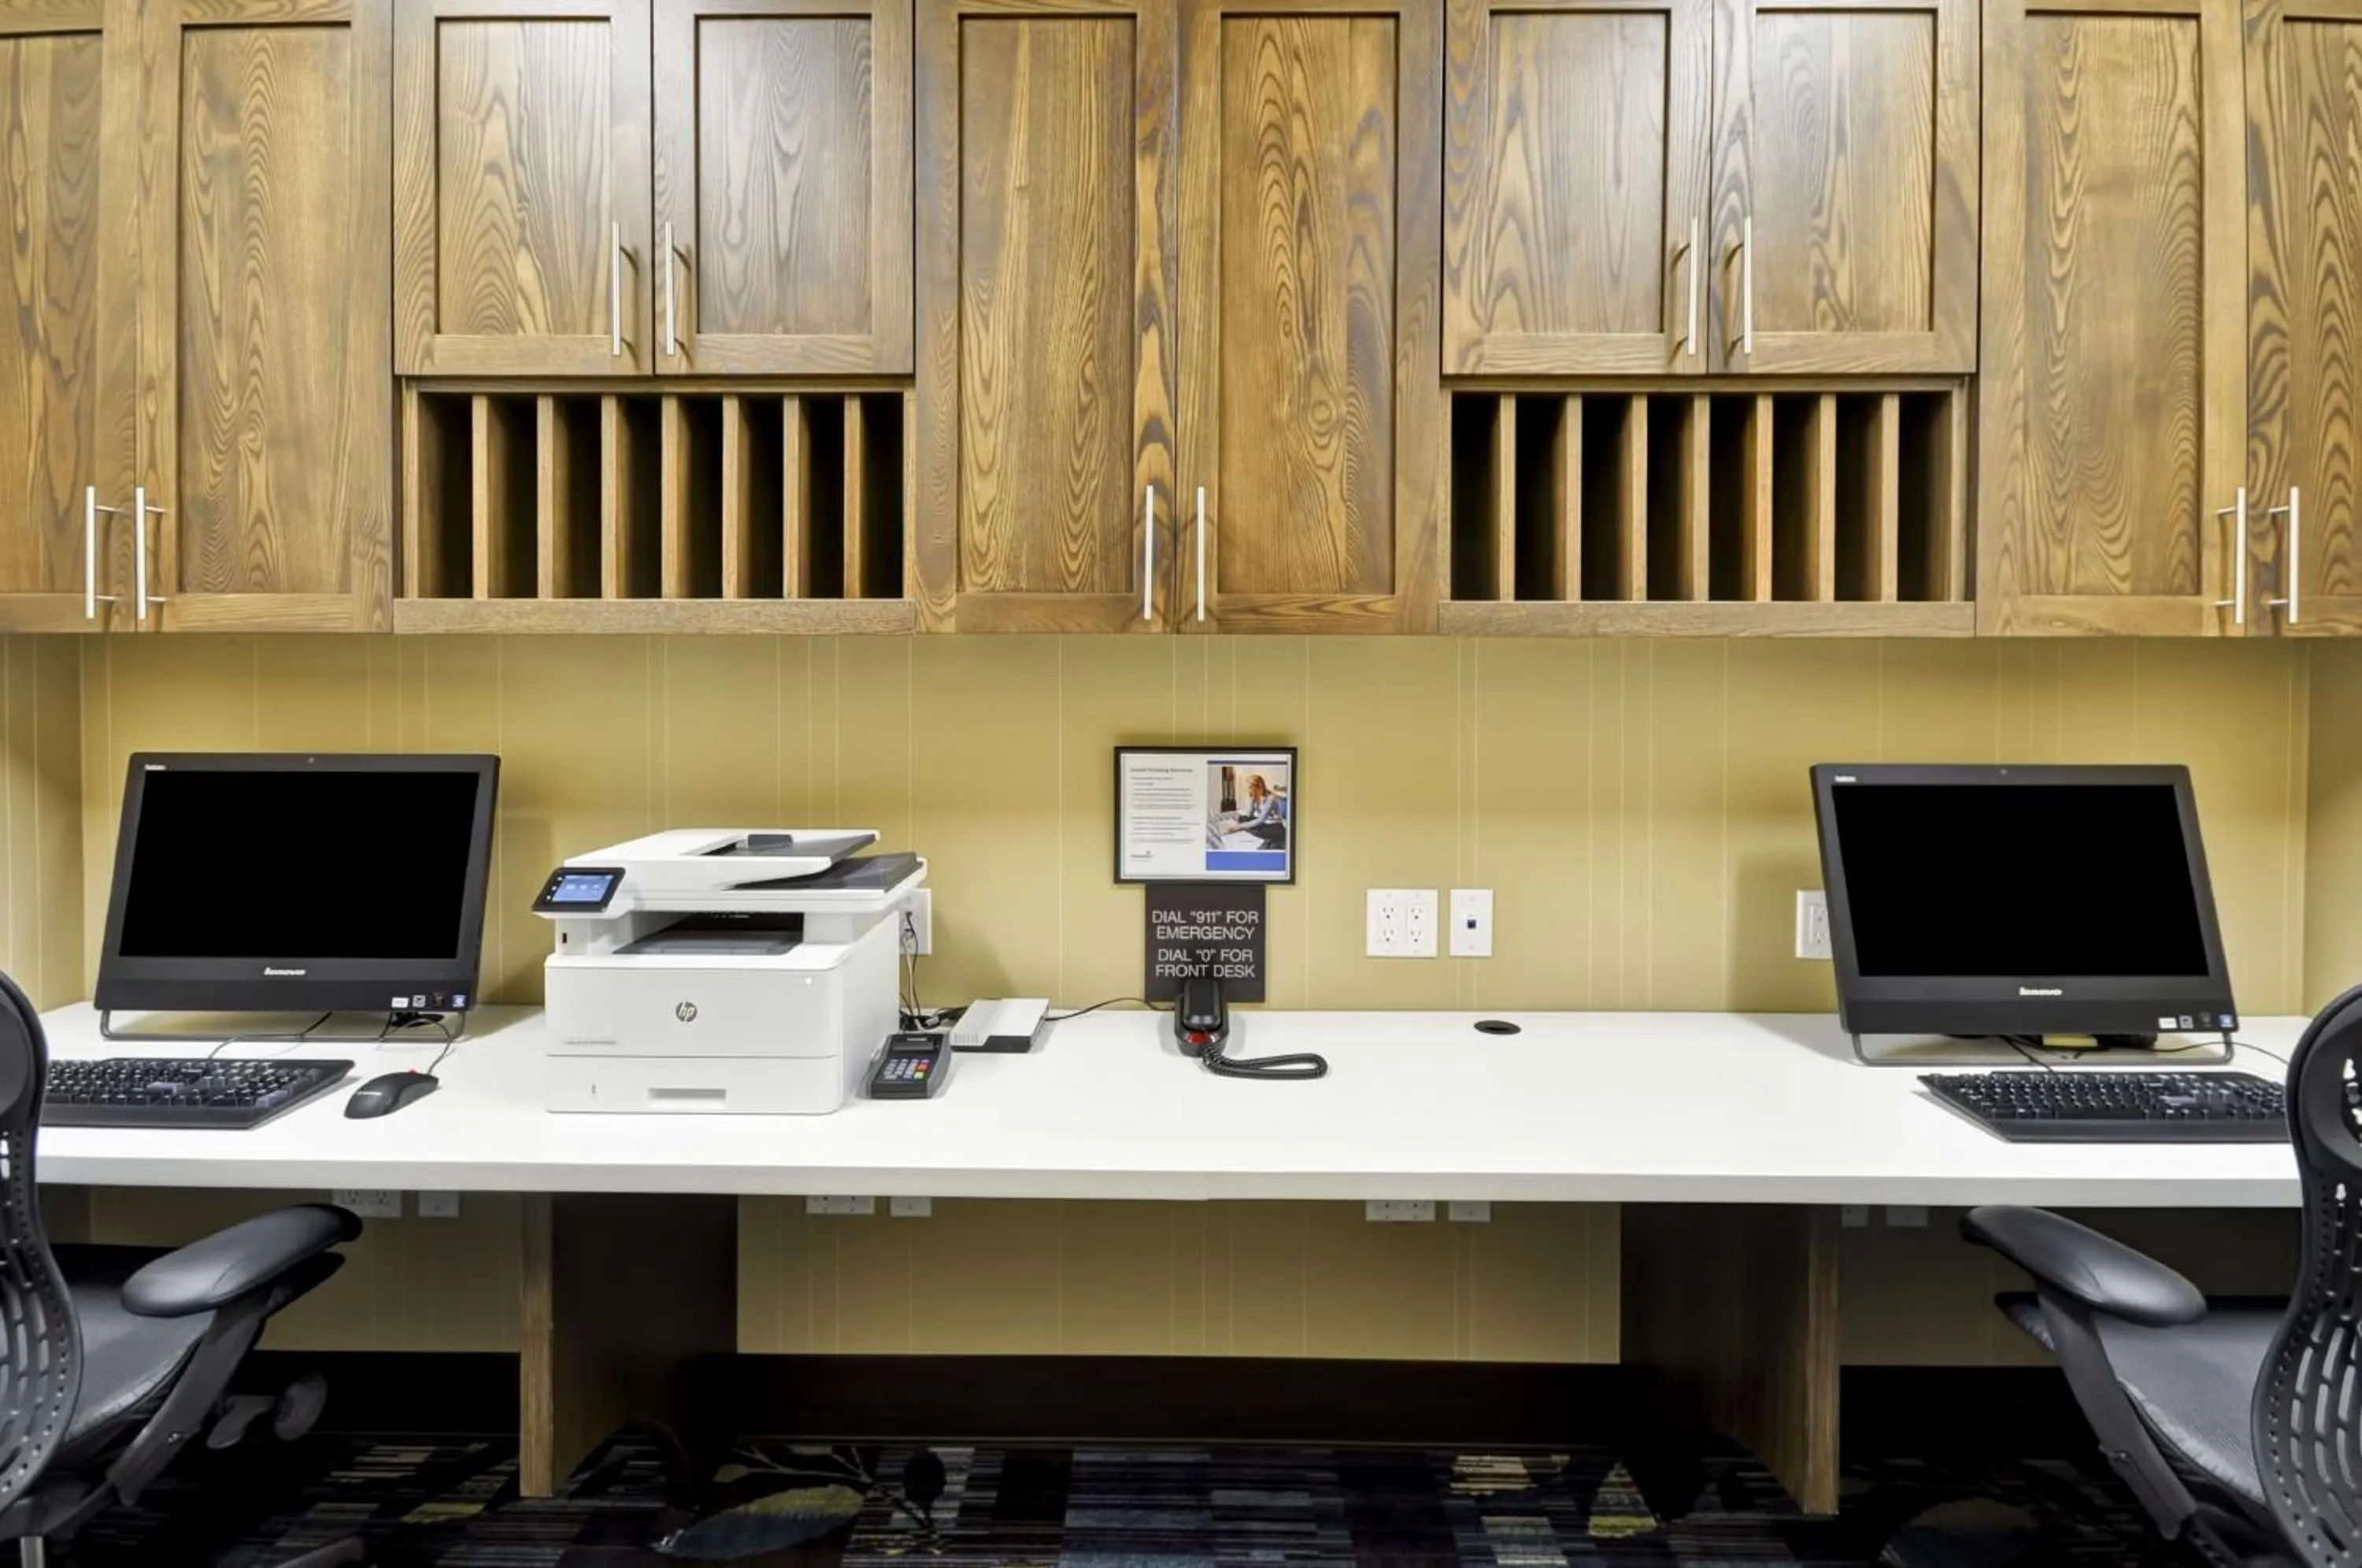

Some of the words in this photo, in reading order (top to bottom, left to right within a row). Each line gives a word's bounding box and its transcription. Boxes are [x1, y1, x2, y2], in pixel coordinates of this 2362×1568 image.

[1152, 910, 1187, 923] DIAL
[1190, 910, 1223, 923] "911"
[1226, 910, 1259, 924] FOR
[1157, 926, 1255, 940] EMERGENCY
[1158, 948, 1192, 961] DIAL
[1220, 948, 1253, 962] FOR
[1155, 963, 1209, 977] FRONT
[1213, 963, 1255, 978] DESK
[676, 1001, 697, 1022] hp
